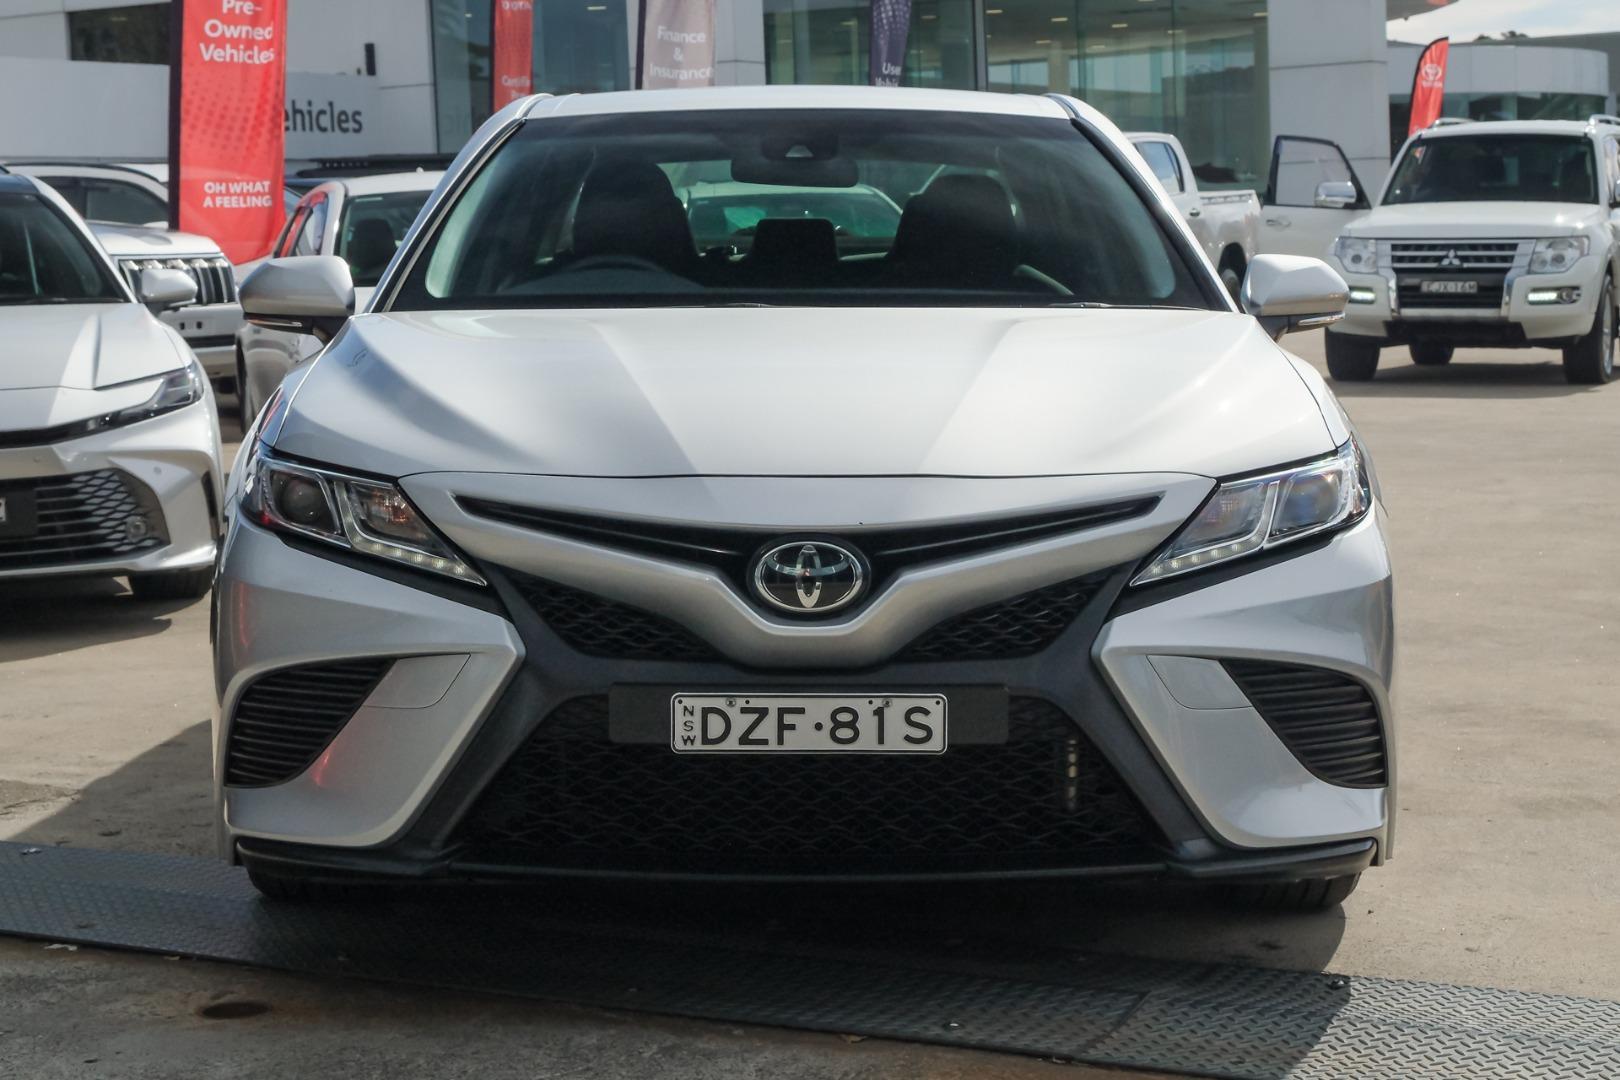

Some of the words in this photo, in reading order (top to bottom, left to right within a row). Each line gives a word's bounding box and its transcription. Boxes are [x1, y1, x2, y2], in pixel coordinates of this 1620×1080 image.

[222, 0, 263, 15] Pre-
[204, 19, 274, 40] Owned
[657, 25, 706, 43] Finance
[199, 42, 275, 64] Vehicles
[673, 47, 684, 62] &
[203, 181, 226, 194] OH
[228, 180, 272, 193] WHAT
[202, 195, 214, 208] A
[215, 194, 273, 208] FEELING
